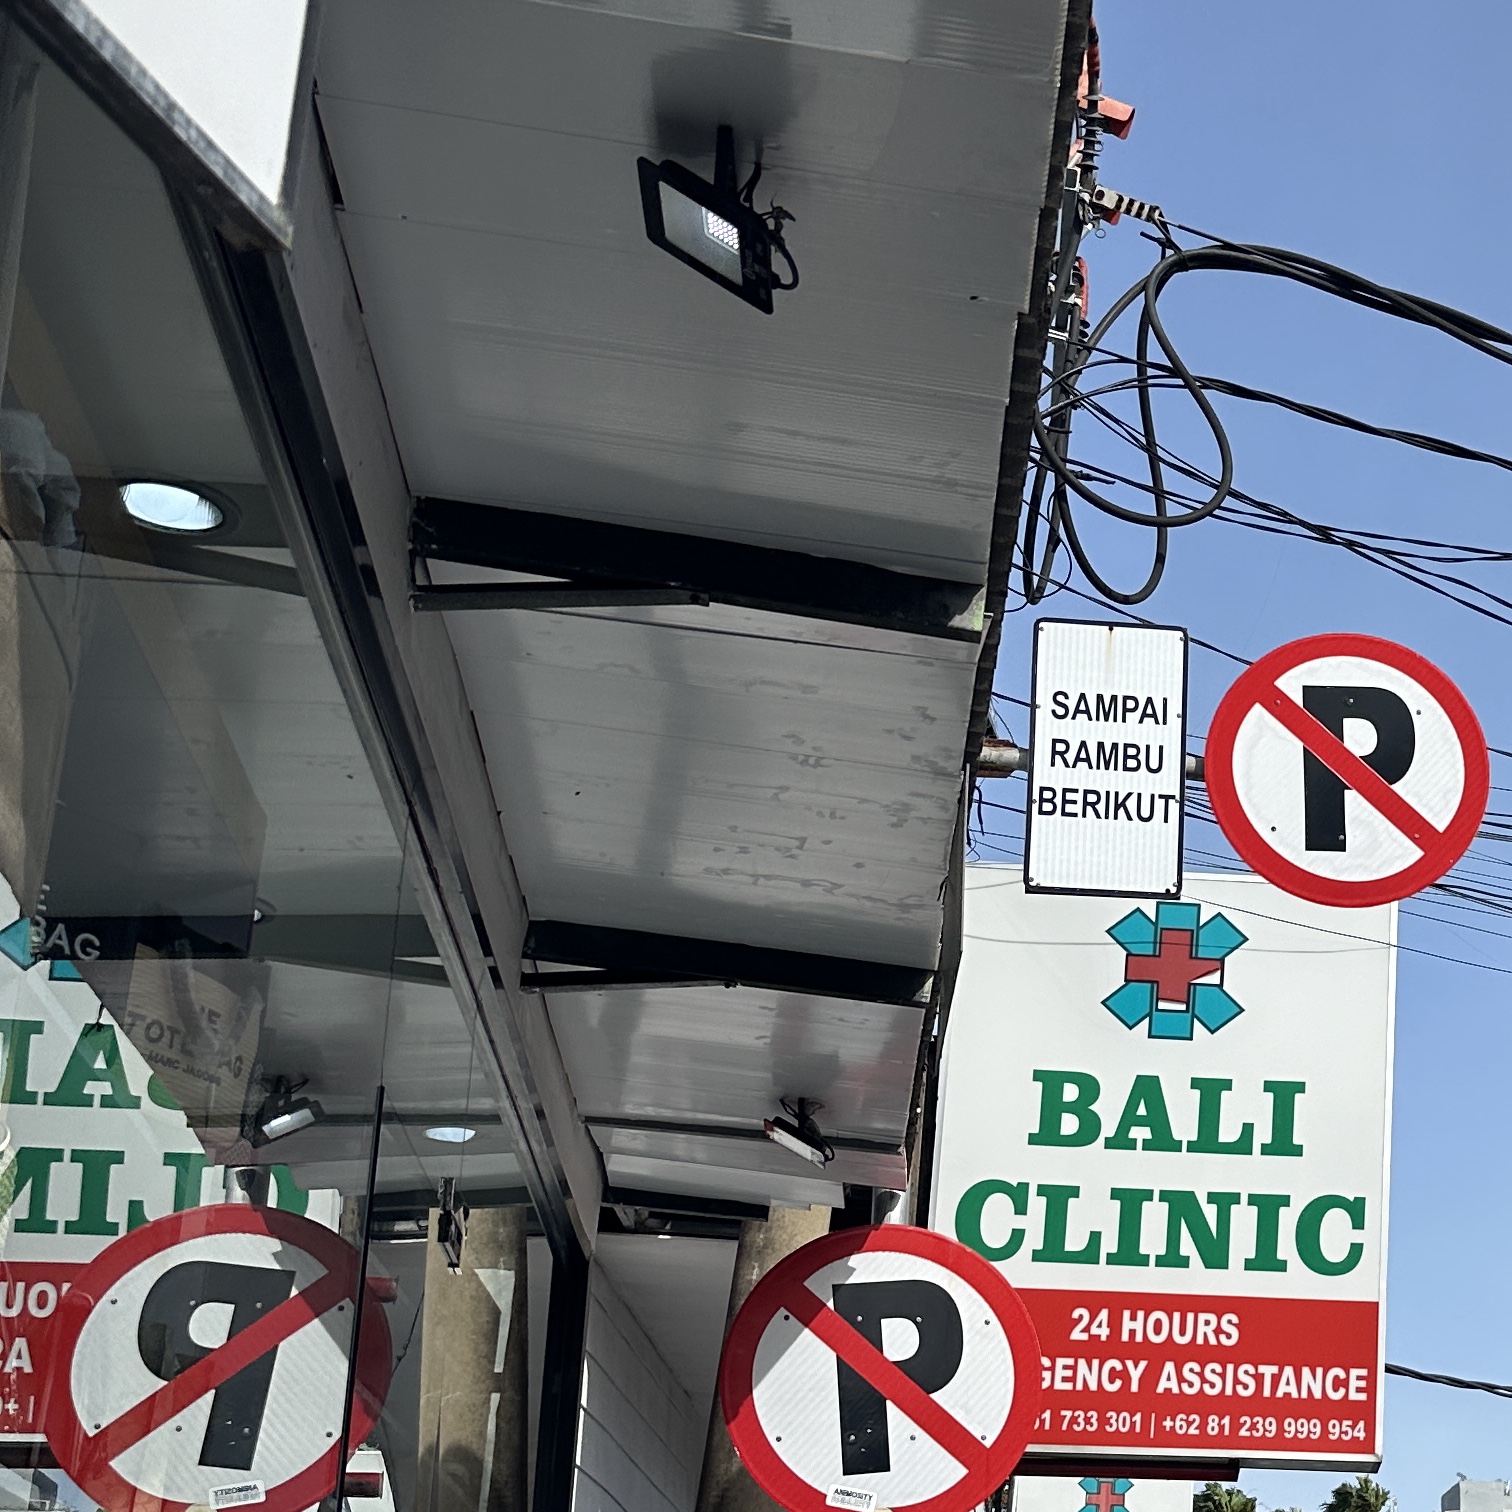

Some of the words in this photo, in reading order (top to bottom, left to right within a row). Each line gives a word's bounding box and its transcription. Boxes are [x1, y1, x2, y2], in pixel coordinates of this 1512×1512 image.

[1051, 690, 1169, 726] SAMPAI
[1050, 738, 1165, 774] RAMBU
[1037, 786, 1176, 825] BERIKUT
[1028, 1069, 1306, 1157] BALI
[955, 1178, 1366, 1277] CLINIC
[1070, 1307, 1110, 1342] 24
[1121, 1310, 1240, 1347] HOURS
[1040, 1356, 1148, 1394] GENCY
[1156, 1360, 1369, 1402] ASSISTANCE
[1060, 1411, 1100, 1433] 733
[1104, 1412, 1142, 1434] 301
[1161, 1414, 1201, 1436] +62
[1206, 1415, 1232, 1437] 81
[1238, 1416, 1277, 1439] 239
[1283, 1418, 1322, 1440] 999
[1328, 1419, 1367, 1442] 954
